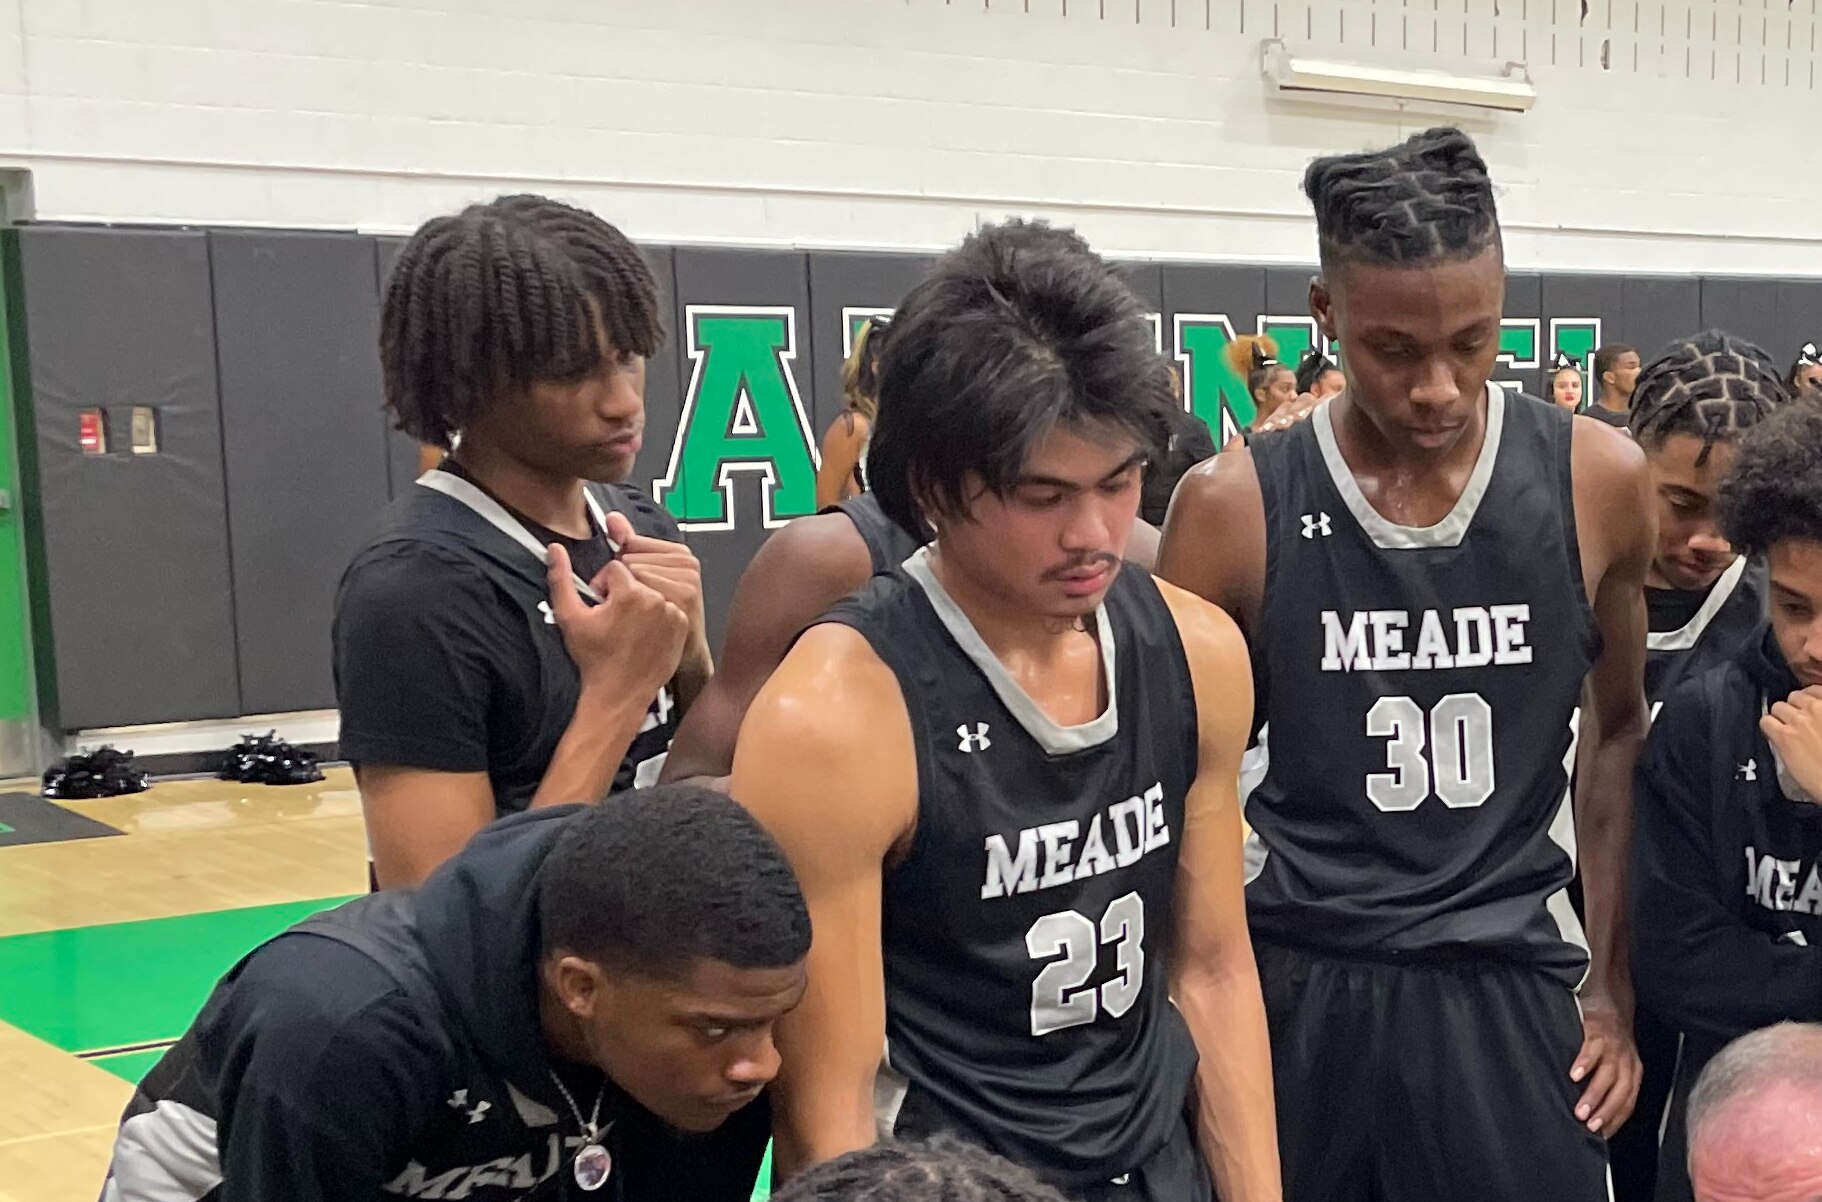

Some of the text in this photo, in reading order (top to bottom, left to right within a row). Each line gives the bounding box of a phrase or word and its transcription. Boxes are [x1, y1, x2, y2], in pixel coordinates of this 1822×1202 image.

[1320, 604, 1533, 672] MEADE
[1366, 692, 1495, 812] 30
[980, 782, 1170, 900] MEADE
[1025, 891, 1144, 1037] 23
